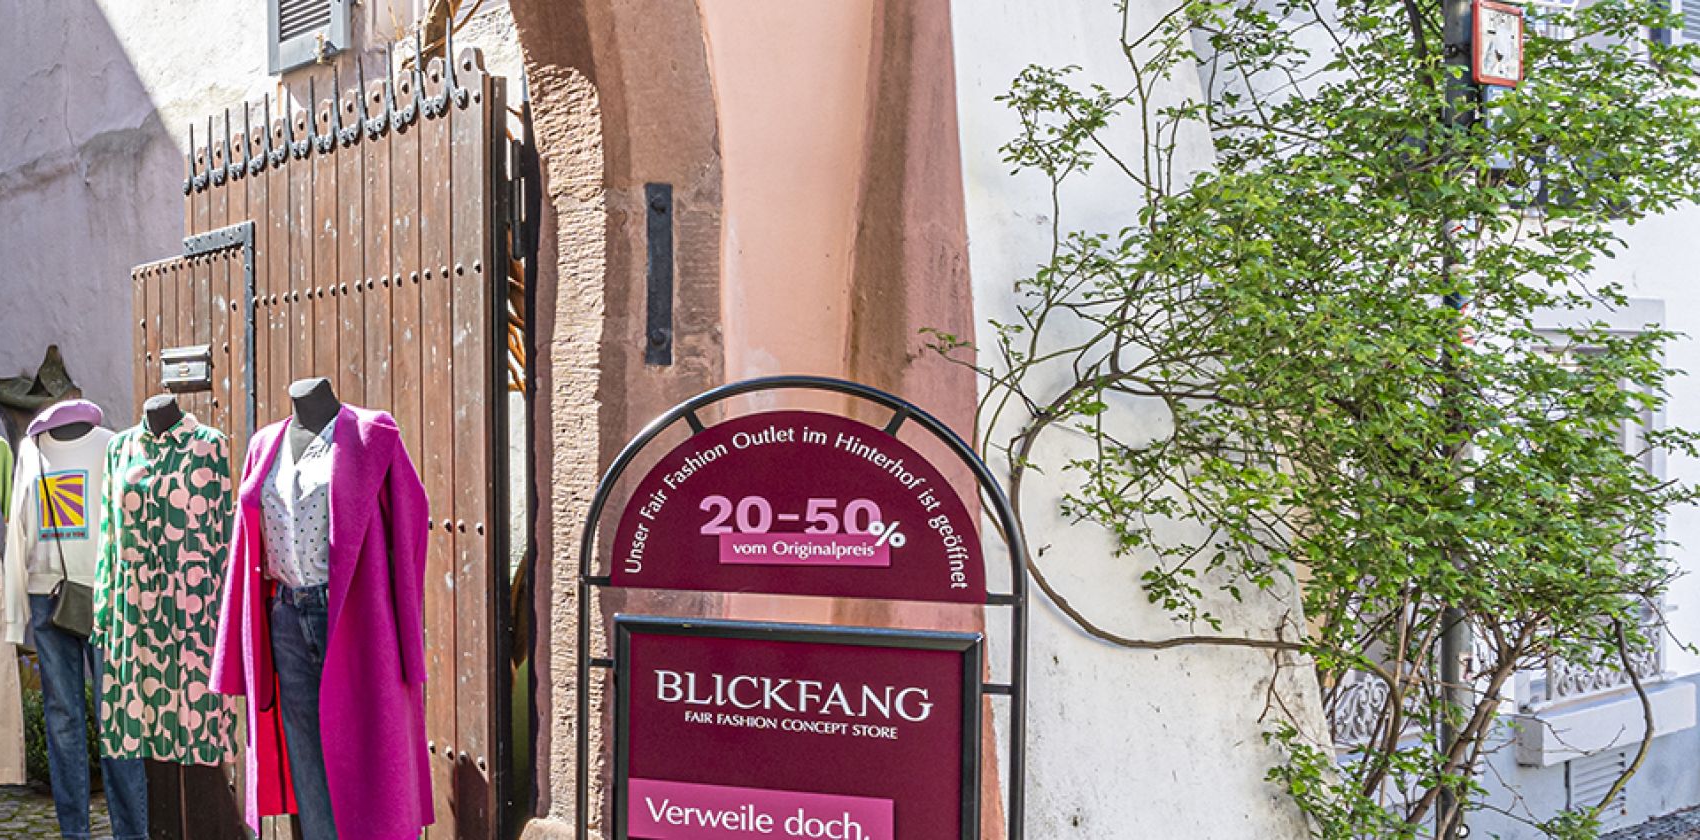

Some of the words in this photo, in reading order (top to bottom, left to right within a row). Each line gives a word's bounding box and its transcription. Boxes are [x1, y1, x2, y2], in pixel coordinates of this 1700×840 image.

[732, 425, 795, 449] Outlet
[802, 427, 827, 444] im
[663, 443, 728, 490] Fashion
[834, 432, 926, 490] Hinterhof
[640, 489, 668, 520] Fair
[917, 488, 941, 513] ist
[625, 522, 649, 574] Unser
[732, 542, 767, 554] vom
[772, 540, 875, 560] Originalpreis
[928, 513, 969, 589] geöffnet
[653, 669, 934, 722] BLICKFANG
[684, 711, 713, 725] FAIR
[716, 713, 778, 730] FASHION
[781, 718, 849, 735] CONCEPT
[852, 723, 899, 740] STORE
[645, 796, 774, 834] Verweile
